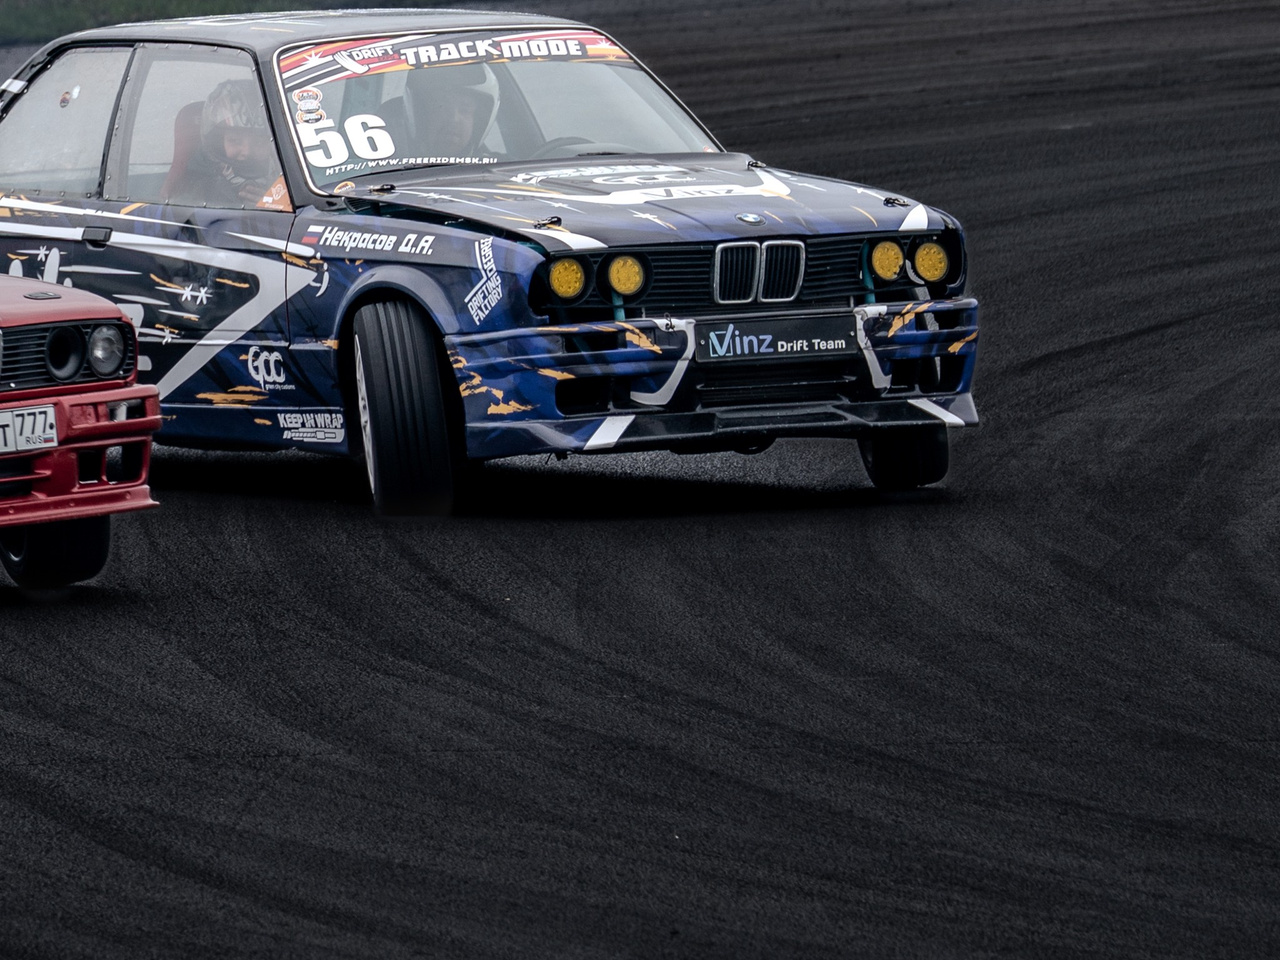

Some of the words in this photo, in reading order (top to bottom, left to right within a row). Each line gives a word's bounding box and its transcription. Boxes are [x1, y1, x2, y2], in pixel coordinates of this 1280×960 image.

[351, 45, 395, 62] DRIFT
[400, 39, 501, 66] TRACK
[500, 39, 583, 58] MODE
[297, 113, 396, 168] 56
[319, 226, 398, 253] Некрасов
[467, 271, 502, 316] DRIFTING
[472, 283, 503, 326] FACTORY
[709, 323, 775, 357] Vinz
[777, 339, 809, 353] Drift
[811, 338, 846, 351] Team
[15, 410, 48, 437] 777
[277, 413, 303, 428] KEEP
[302, 413, 315, 428] IN
[315, 413, 344, 428] WRAP
[25, 434, 44, 446] RUS
